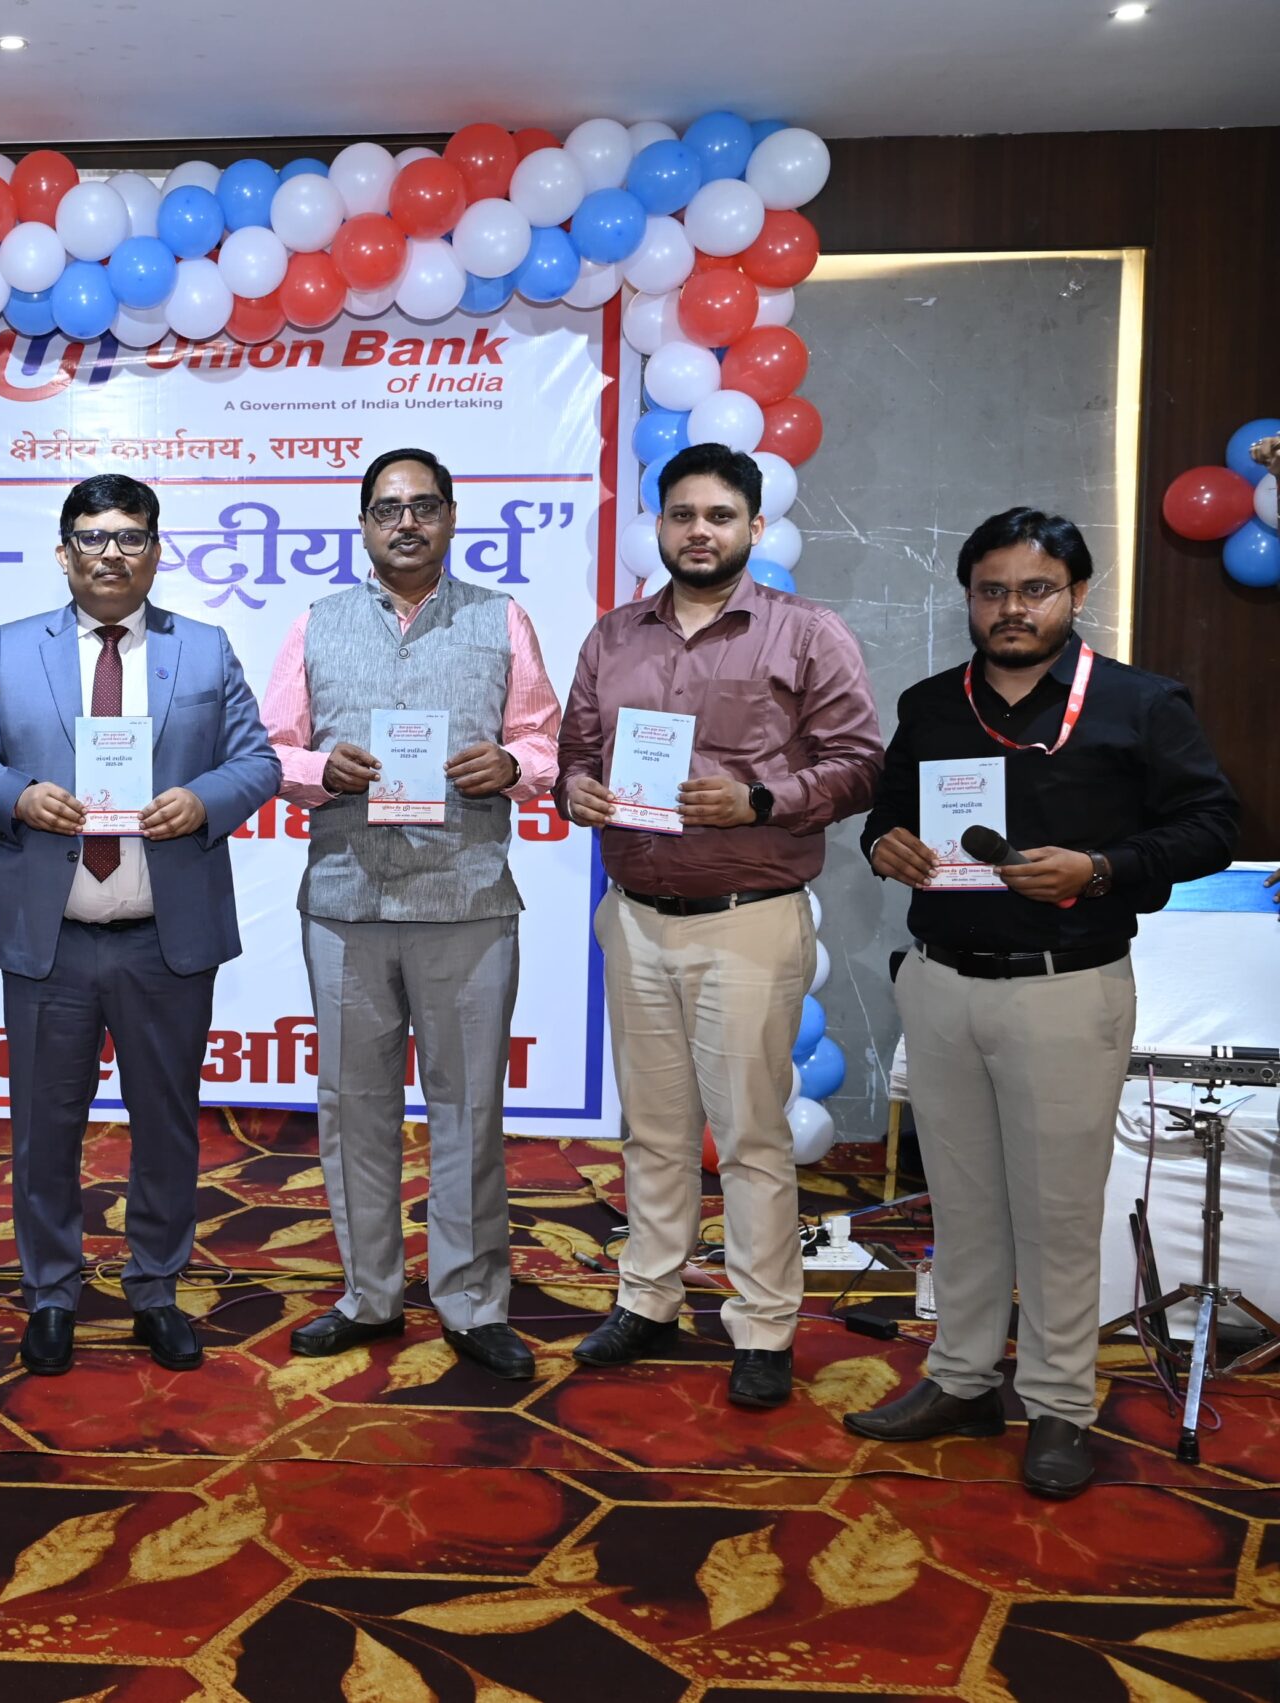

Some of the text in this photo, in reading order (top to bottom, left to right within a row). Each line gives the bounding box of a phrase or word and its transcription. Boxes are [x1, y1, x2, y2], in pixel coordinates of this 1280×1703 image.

[145, 328, 509, 369] Union Bank
[386, 372, 504, 393] of India
[224, 397, 504, 412] A Government of India Undertaking
[10, 429, 100, 462] क्षेत्रीय
[269, 436, 363, 467] रायपुर
